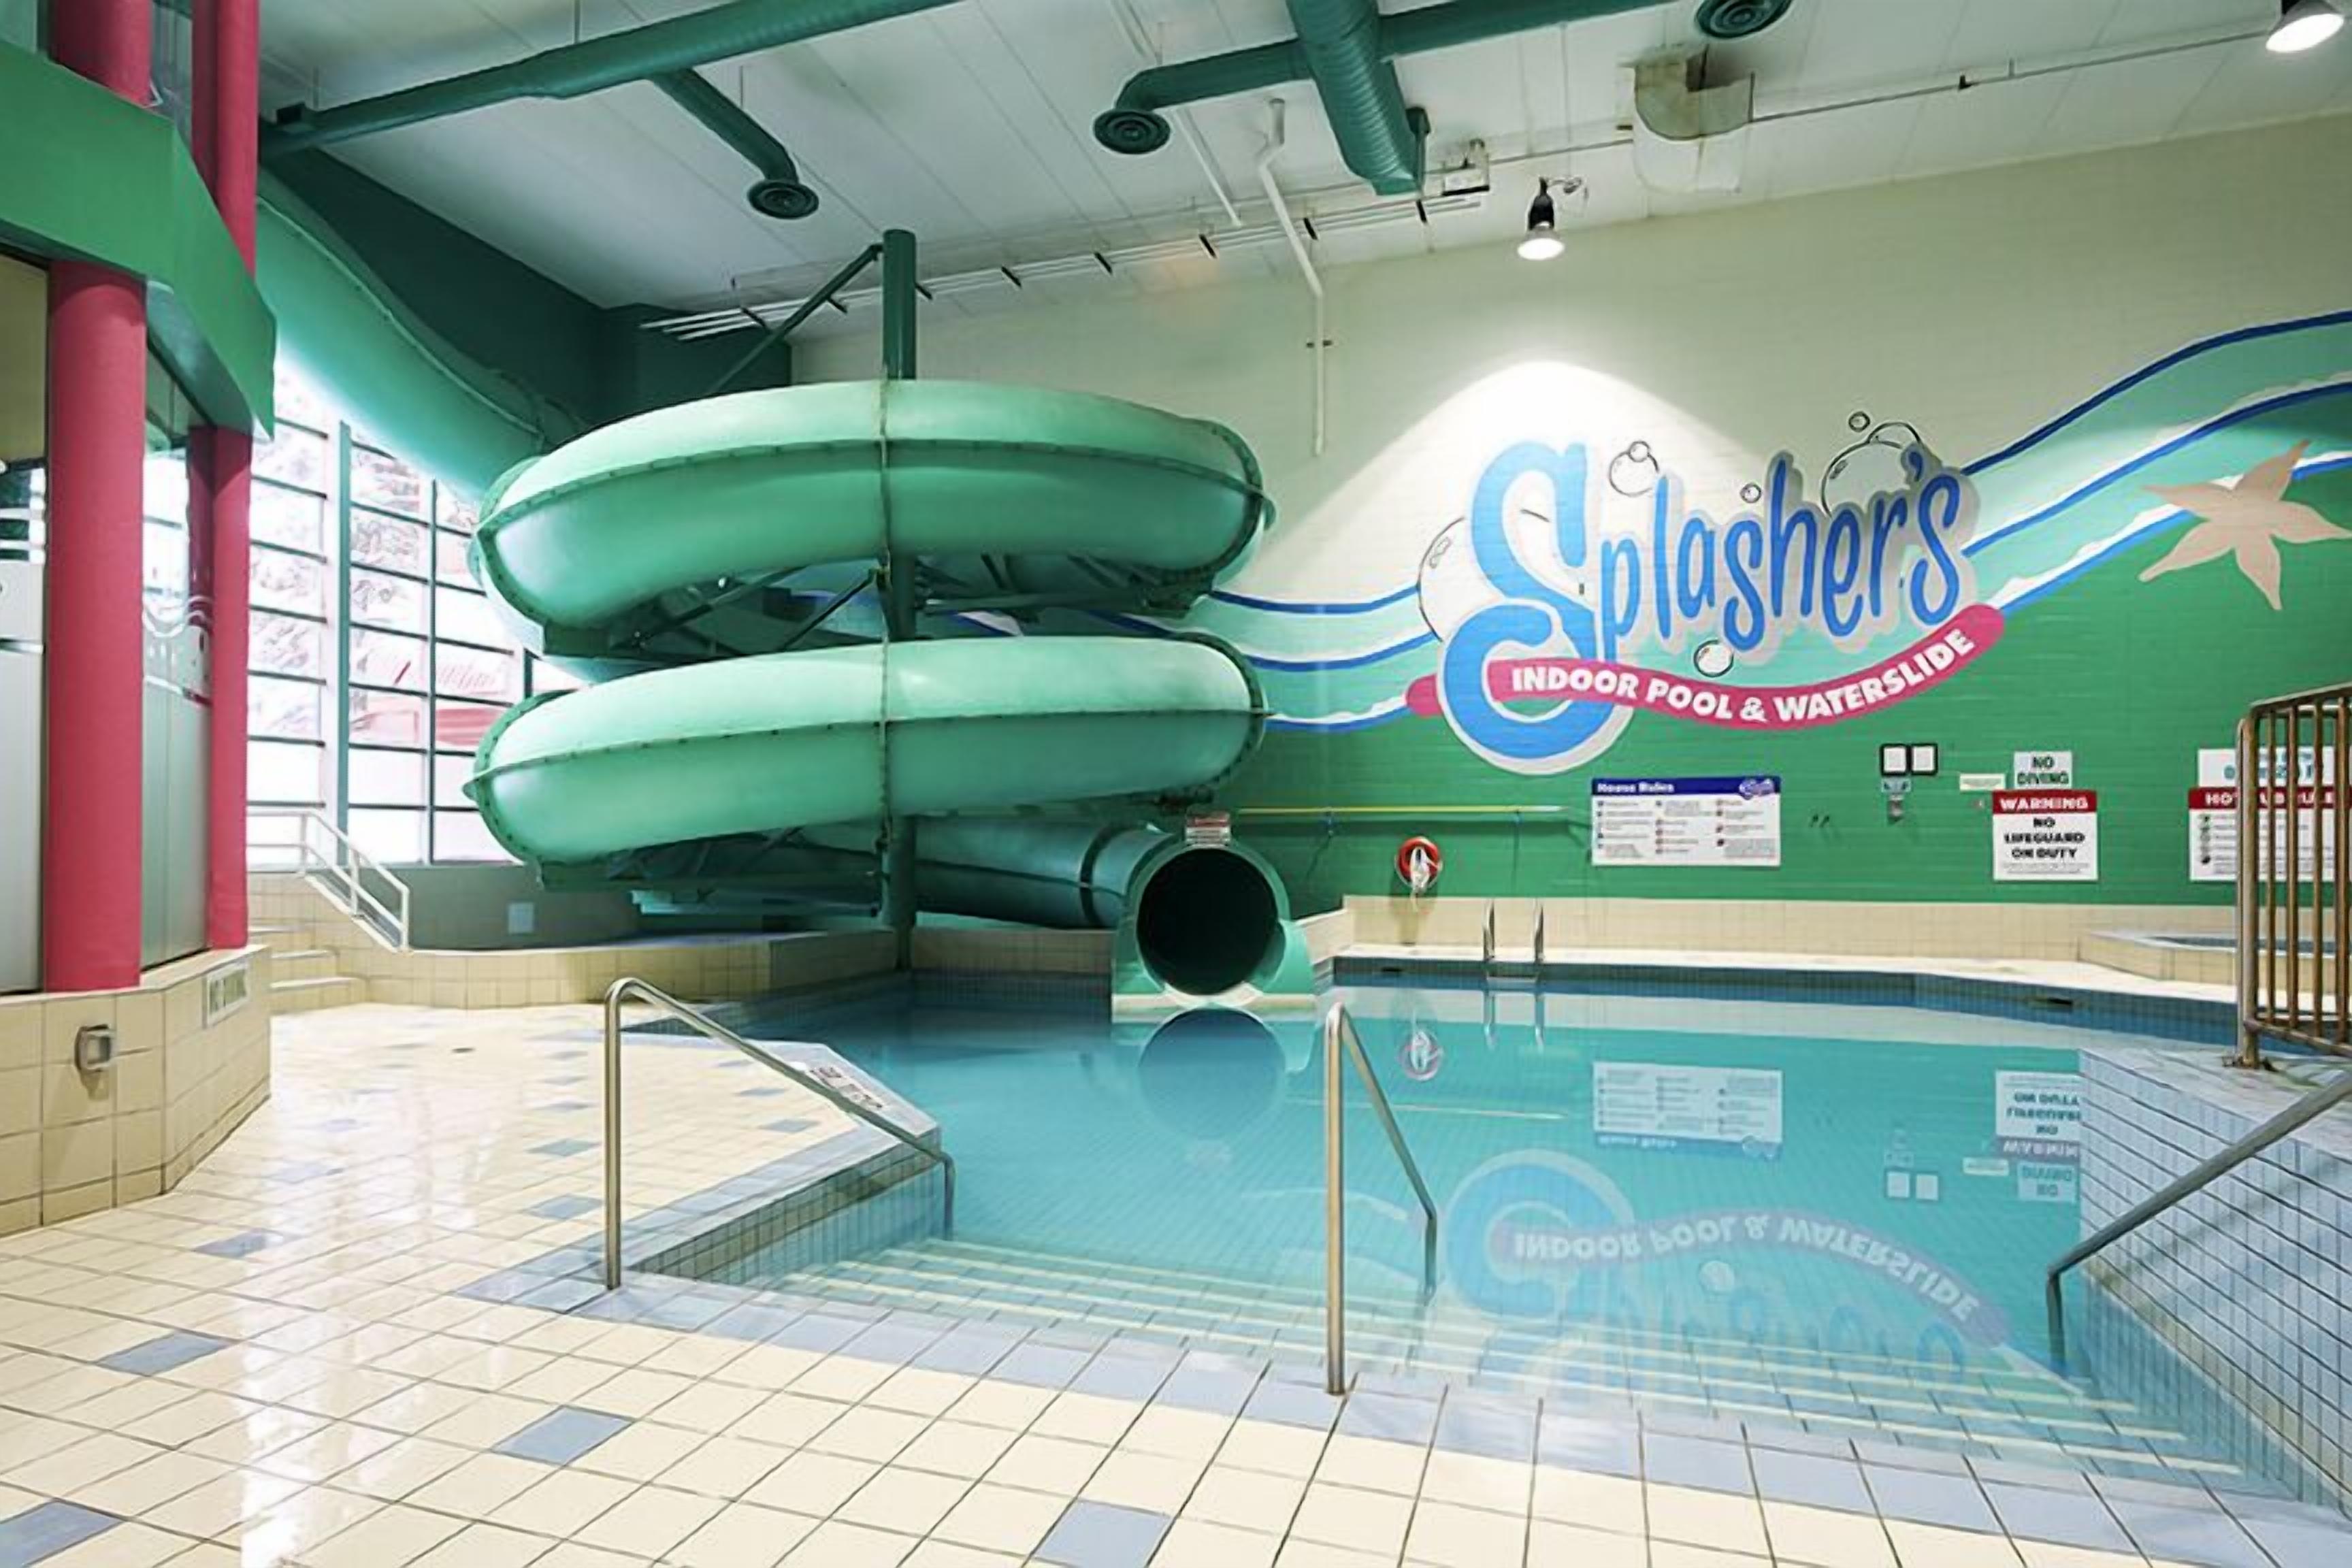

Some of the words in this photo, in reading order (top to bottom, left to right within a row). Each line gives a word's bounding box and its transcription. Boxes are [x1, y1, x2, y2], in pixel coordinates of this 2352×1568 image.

[1443, 440, 1960, 758] Splasher's
[1512, 666, 1639, 700] INDOOR
[1645, 677, 1733, 720] POOL
[1739, 696, 1767, 723] &
[1773, 628, 1975, 722] WATERSLIDE
[2031, 755, 2055, 768] NO
[1999, 797, 2089, 810] WARNING
[2033, 817, 2056, 828] NO
[2004, 832, 2085, 843] LIFEGUARD
[2012, 848, 2034, 858] ON
[2036, 848, 2077, 859] DUTY
